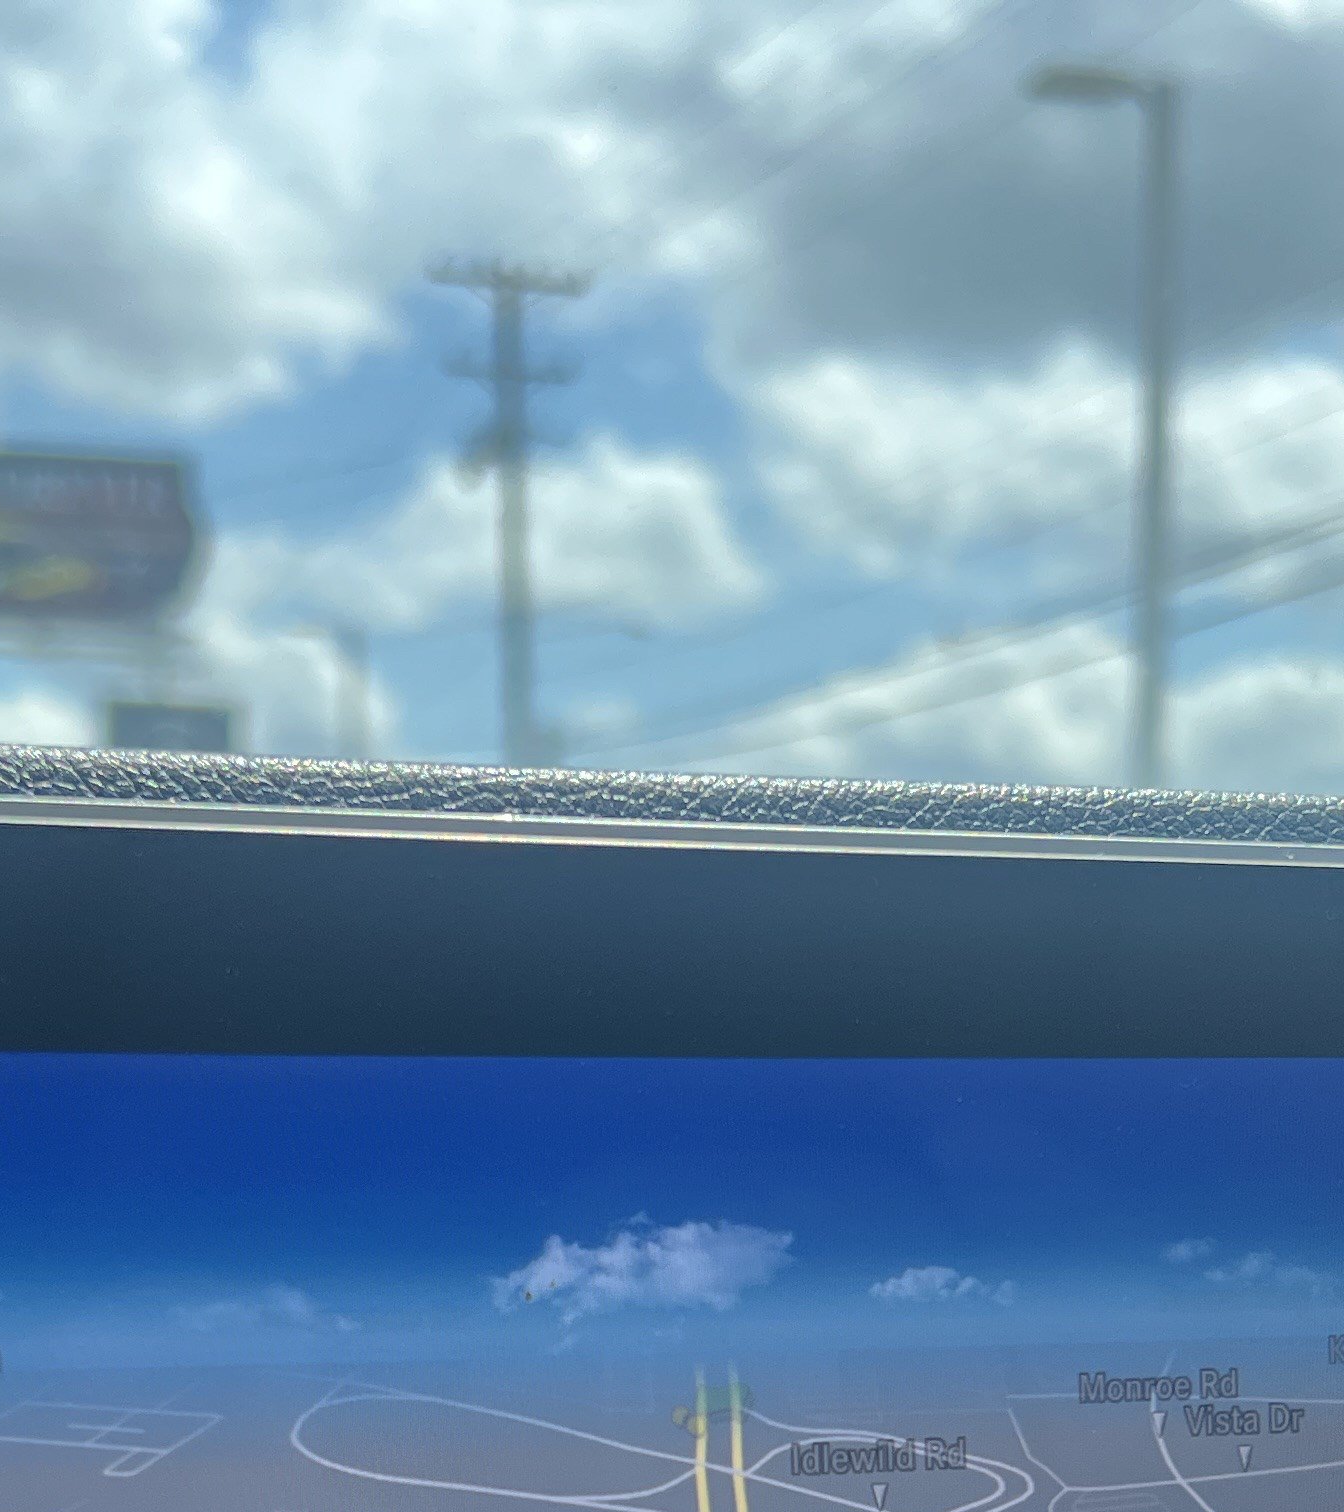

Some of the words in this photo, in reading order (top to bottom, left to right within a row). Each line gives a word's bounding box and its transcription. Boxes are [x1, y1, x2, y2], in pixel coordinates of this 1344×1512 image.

[1079, 1372, 1191, 1403] Monroe
[1200, 1368, 1238, 1398] Rd
[1184, 1404, 1259, 1436] Vista
[1269, 1403, 1304, 1433] Dr
[791, 1441, 917, 1475] Idlewild
[924, 1437, 966, 1470] Rd
